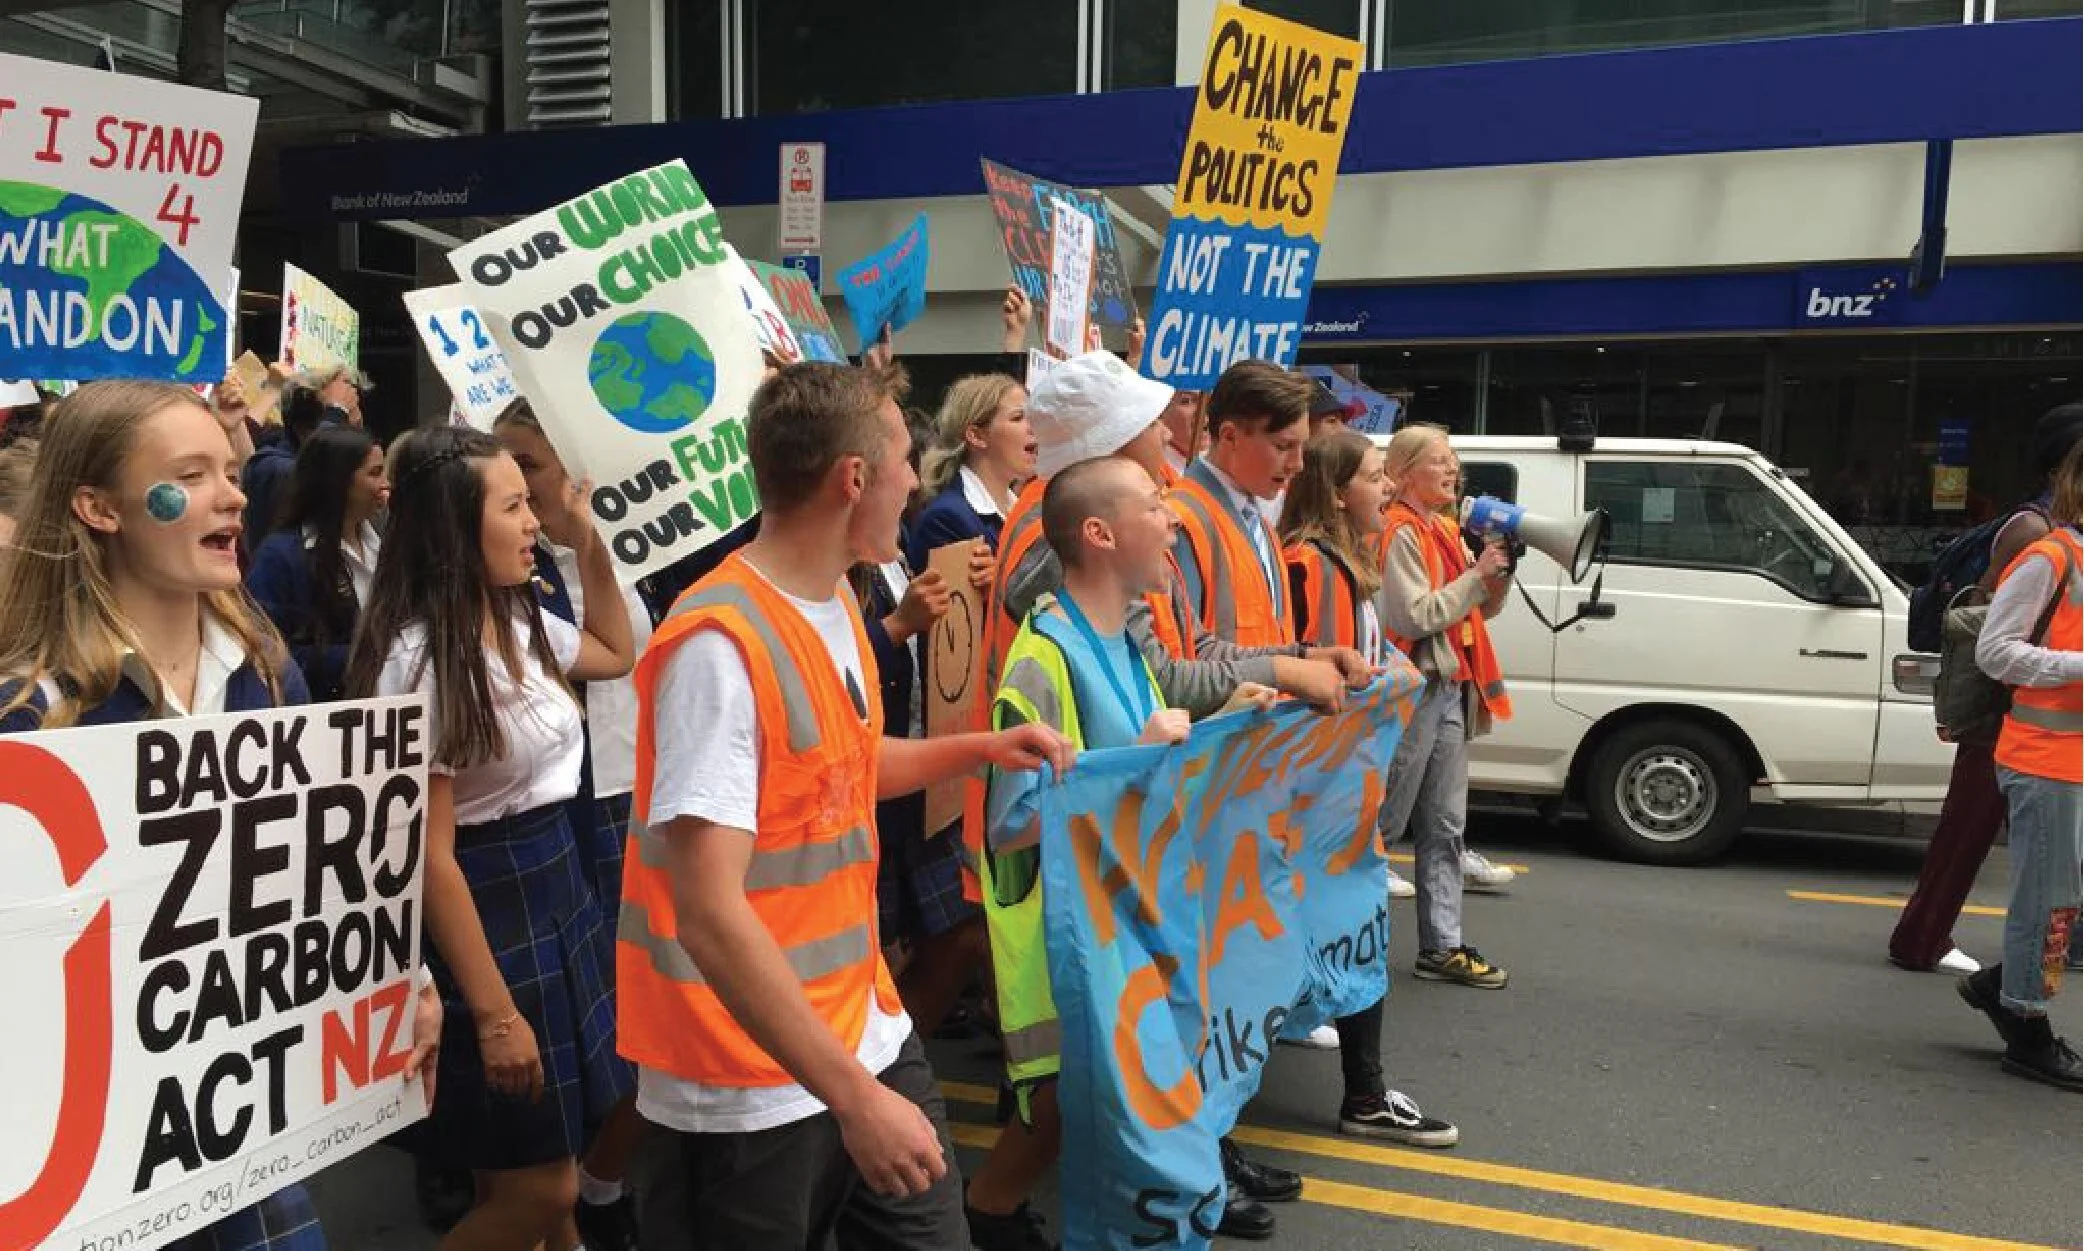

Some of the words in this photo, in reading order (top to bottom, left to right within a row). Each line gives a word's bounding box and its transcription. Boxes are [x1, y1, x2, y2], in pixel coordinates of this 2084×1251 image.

[1207, 19, 1353, 133] CHANGE
[34, 106, 71, 163] I
[89, 114, 224, 177] STAND
[1257, 123, 1284, 152] the
[157, 182, 200, 246] 4
[412, 185, 469, 207] Zealand
[1183, 140, 1318, 218] POLITICS
[471, 231, 567, 286] OUR
[556, 165, 706, 249] WORLD
[512, 283, 611, 349] OUR
[597, 212, 727, 304] CHOICE
[1166, 233, 1231, 295] NOT
[1243, 243, 1309, 299] THE
[429, 314, 460, 357] 1
[460, 308, 490, 349] 2
[1806, 287, 1874, 317] bnz
[1151, 308, 1298, 377] CLIMATE
[591, 460, 681, 522] OUR
[612, 502, 706, 565] OUR
[137, 715, 312, 815] BACK
[328, 705, 423, 779] THE
[139, 773, 423, 961] ZERO
[137, 899, 413, 1054] CARBON
[133, 1024, 304, 1194] ACT
[322, 978, 415, 1107] NZ
